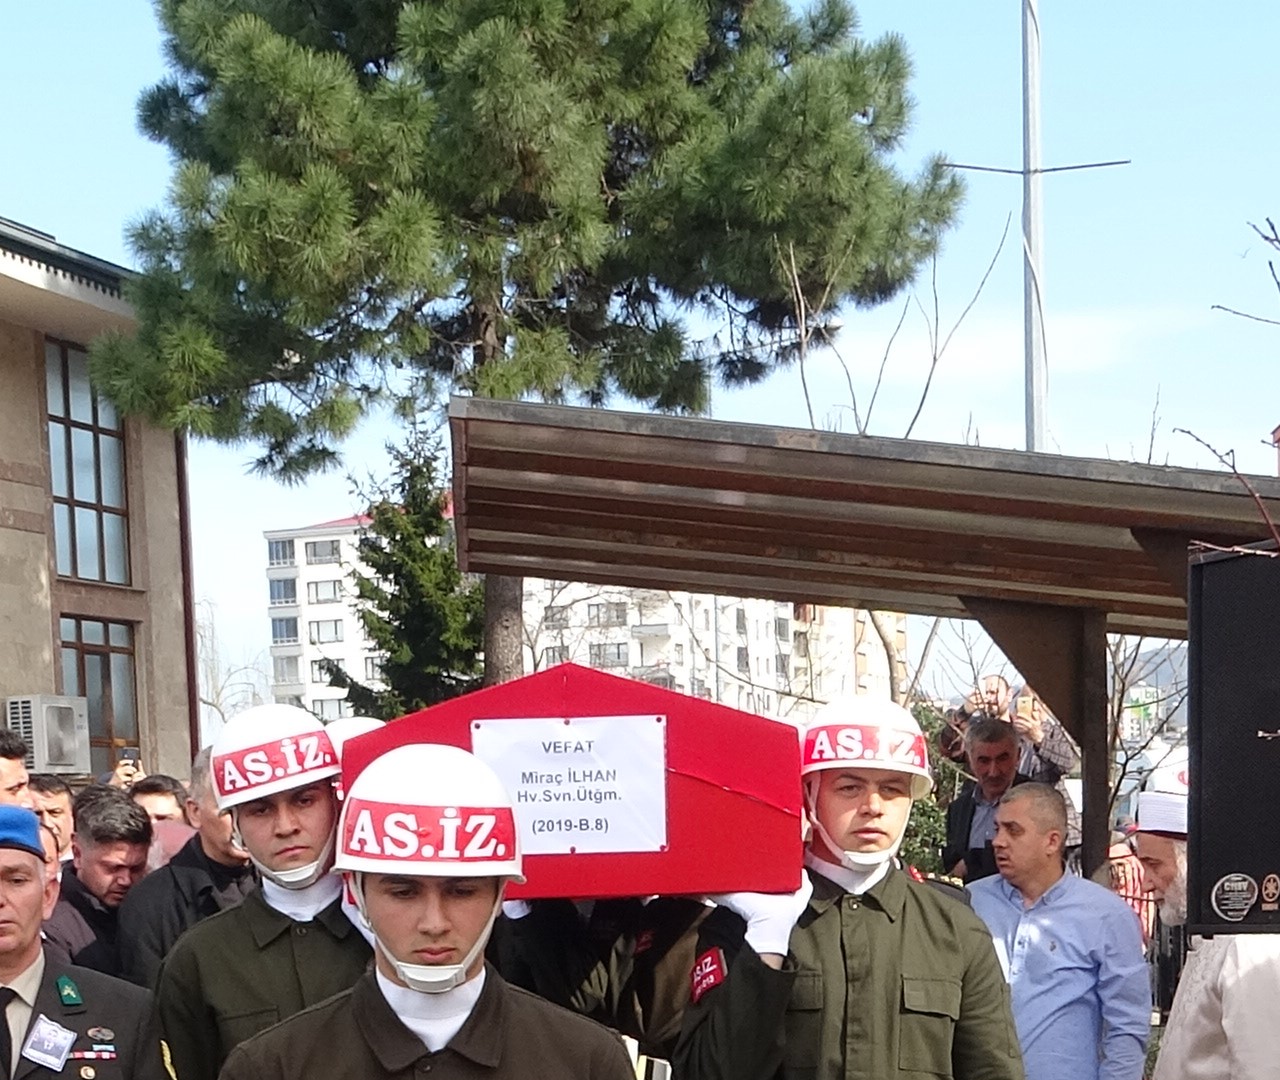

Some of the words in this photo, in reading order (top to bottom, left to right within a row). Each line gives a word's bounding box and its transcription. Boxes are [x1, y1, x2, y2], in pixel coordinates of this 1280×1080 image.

[542, 740, 594, 754] VEFAT
[521, 771, 563, 786] Miraç
[568, 768, 617, 783] İLHAN
[517, 785, 622, 804] Hv.Svn.Ütğm.
[531, 818, 609, 835] (2019-B.8)
